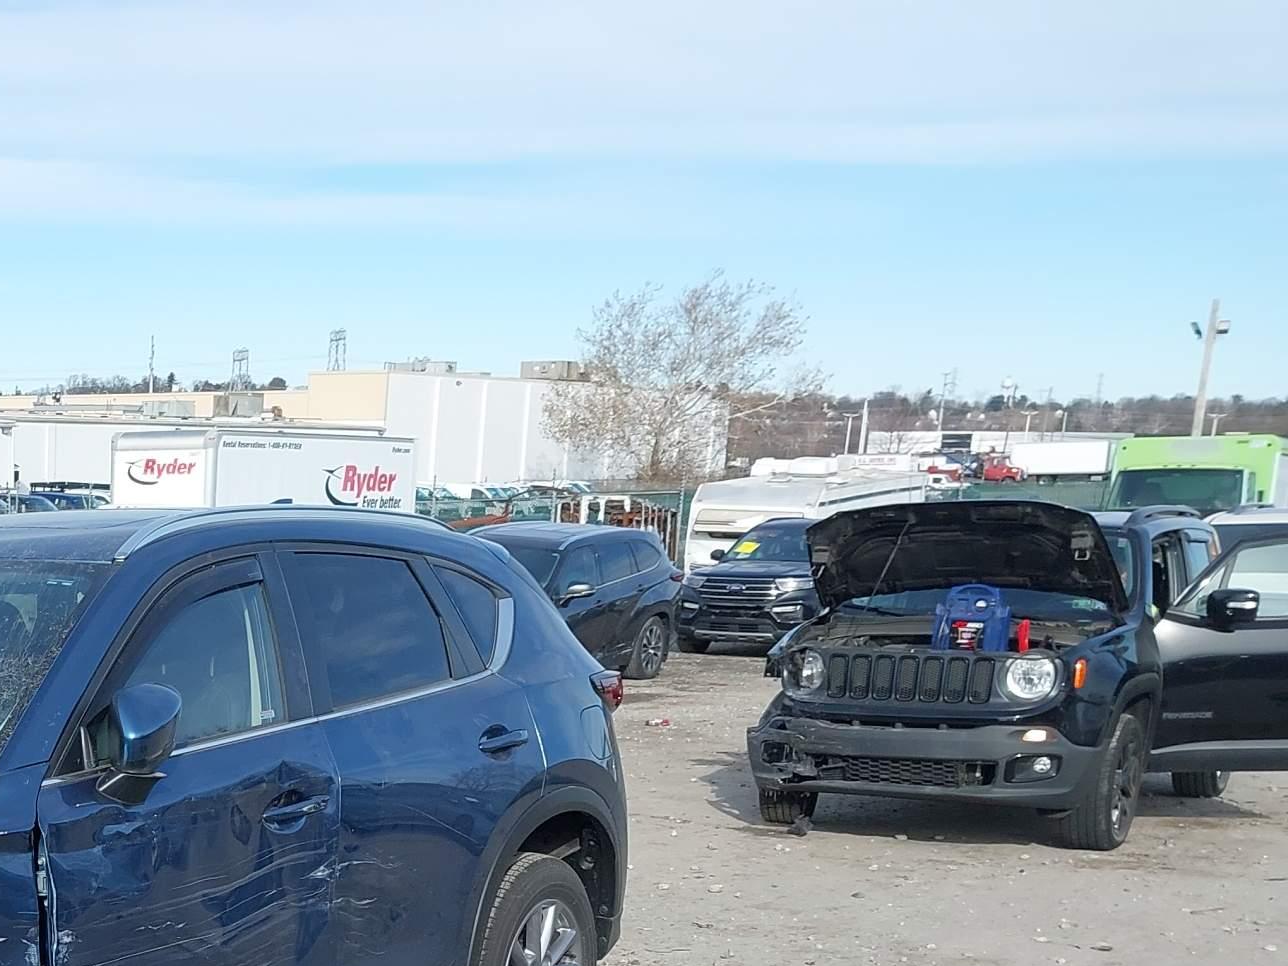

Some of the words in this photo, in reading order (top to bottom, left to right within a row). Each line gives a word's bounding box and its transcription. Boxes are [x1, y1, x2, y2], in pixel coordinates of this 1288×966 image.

[143, 458, 196, 479] Ryder
[342, 465, 397, 498] Ryder
[362, 495, 378, 508] Ever
